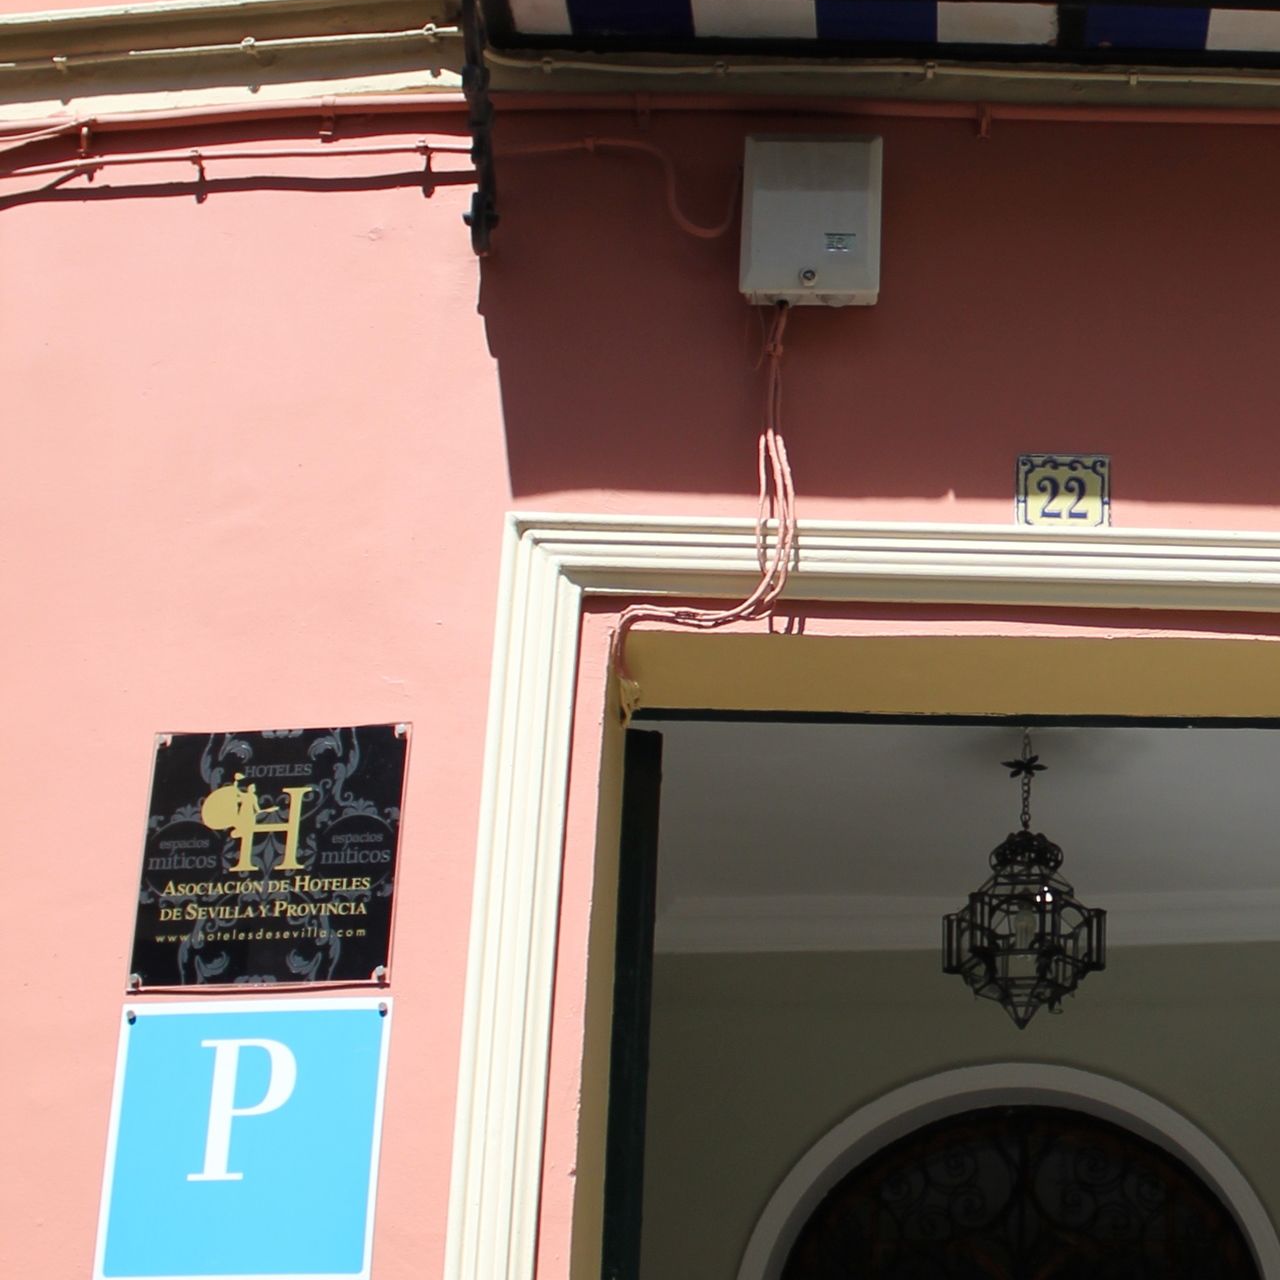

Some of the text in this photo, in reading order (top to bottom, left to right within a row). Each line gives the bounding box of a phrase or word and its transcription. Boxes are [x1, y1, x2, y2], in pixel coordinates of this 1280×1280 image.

[1036, 475, 1088, 519] 22
[244, 764, 313, 778] HOTELES
[159, 837, 210, 856] espacios
[331, 831, 384, 849] espacios
[160, 875, 371, 897] ASOCIACIÓN DE HOTELES
[159, 900, 367, 921] DE SEVILLA Y PROVINCIA
[155, 926, 367, 944] www.hotelesdesevilla.com
[187, 1038, 297, 1182] P
